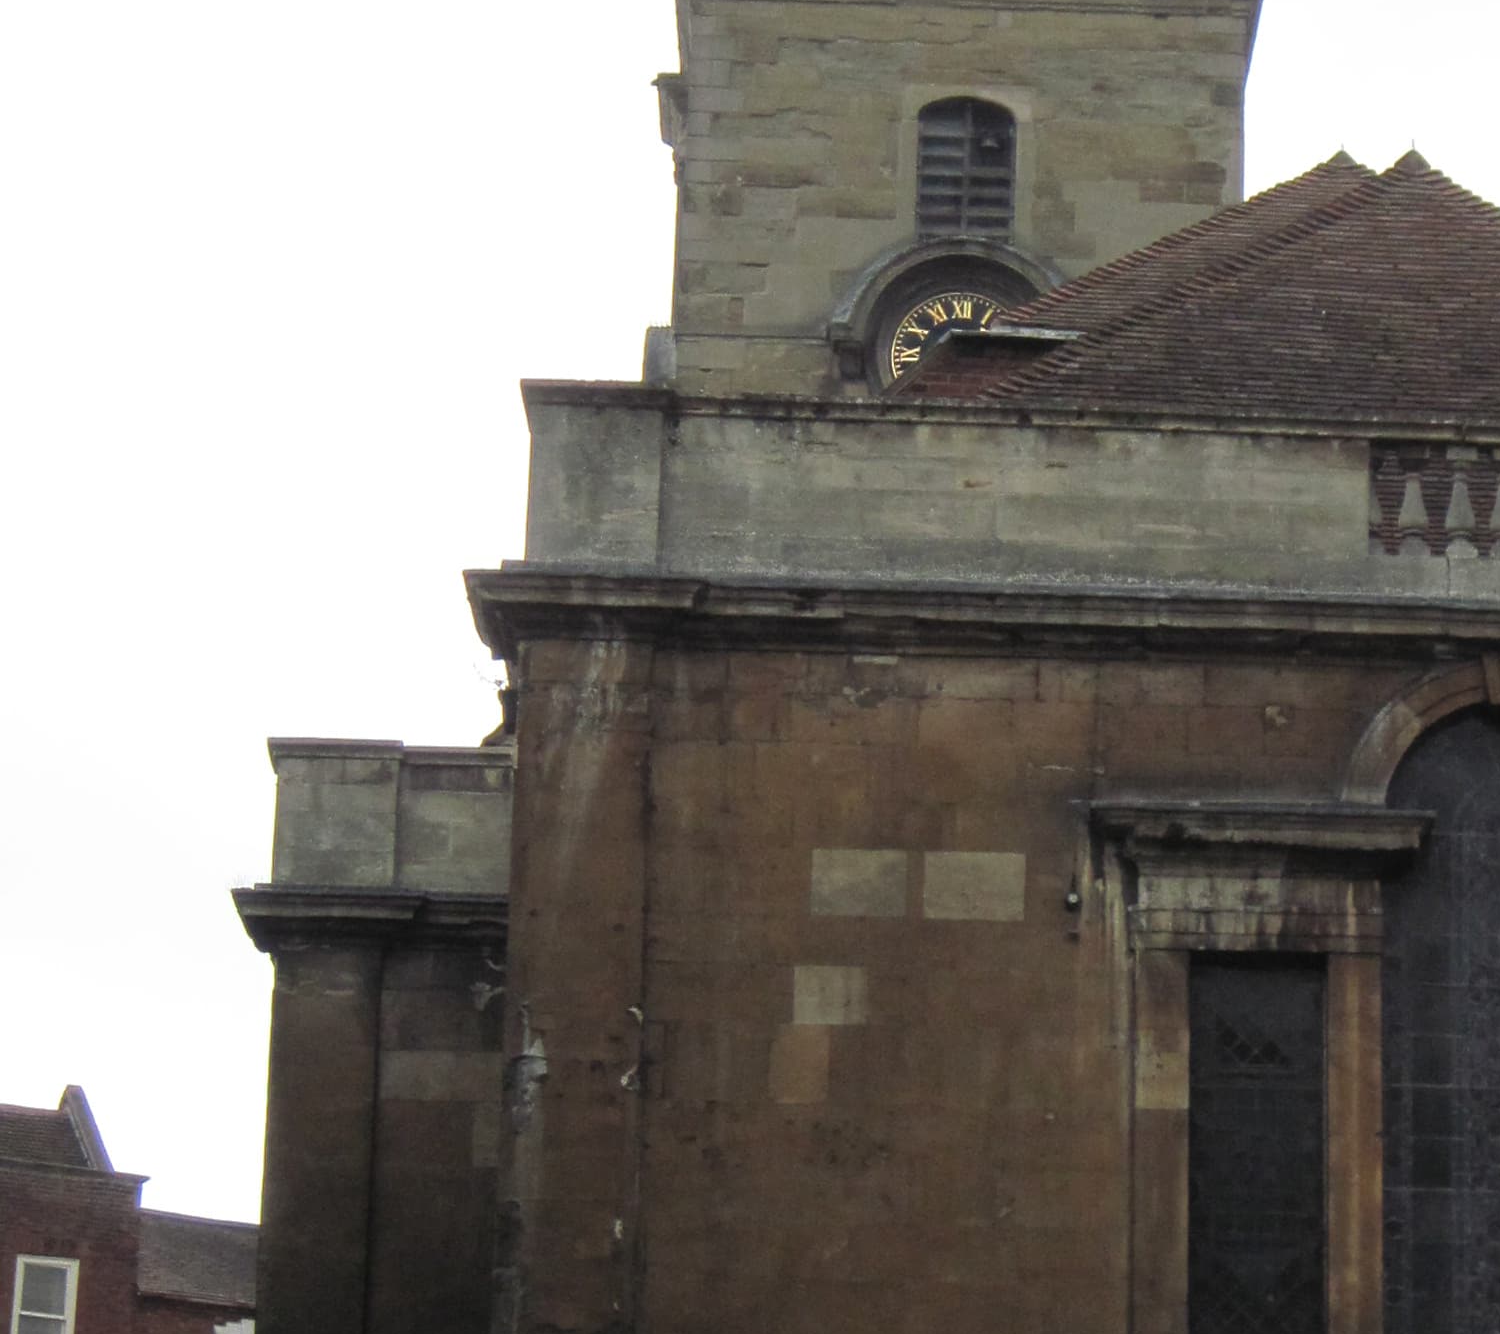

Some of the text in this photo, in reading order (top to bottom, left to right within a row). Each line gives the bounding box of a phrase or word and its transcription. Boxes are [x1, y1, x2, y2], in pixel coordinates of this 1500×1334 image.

[926, 301, 949, 326] XI
[951, 300, 972, 320] XII
[908, 317, 929, 341] X
[899, 346, 921, 363] IX
